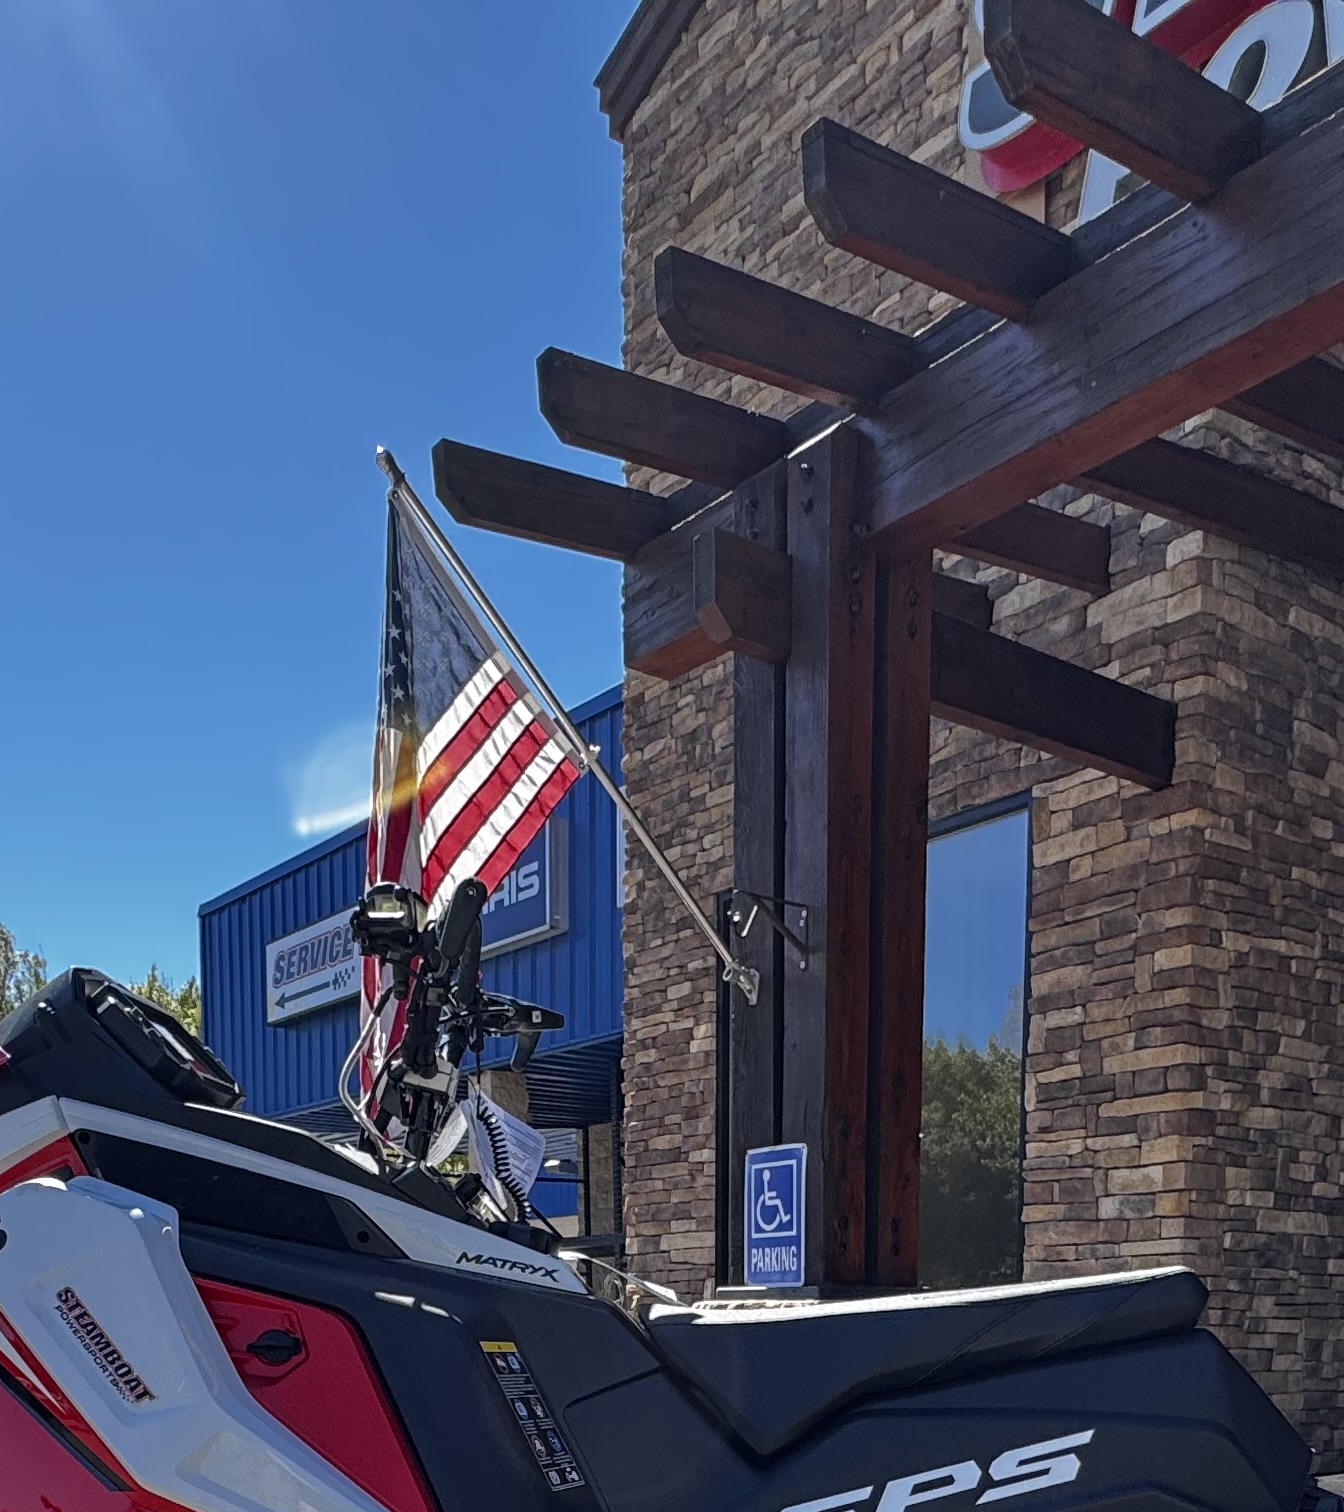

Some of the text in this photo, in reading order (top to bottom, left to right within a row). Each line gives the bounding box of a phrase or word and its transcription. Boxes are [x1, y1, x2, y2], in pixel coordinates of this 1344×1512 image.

[273, 923, 355, 989] SERVICE
[456, 1251, 560, 1283] MATRYX
[751, 1245, 798, 1273] PARKING
[55, 1304, 121, 1388] POWERSPORTS
[56, 1287, 157, 1403] STEAMBOAT
